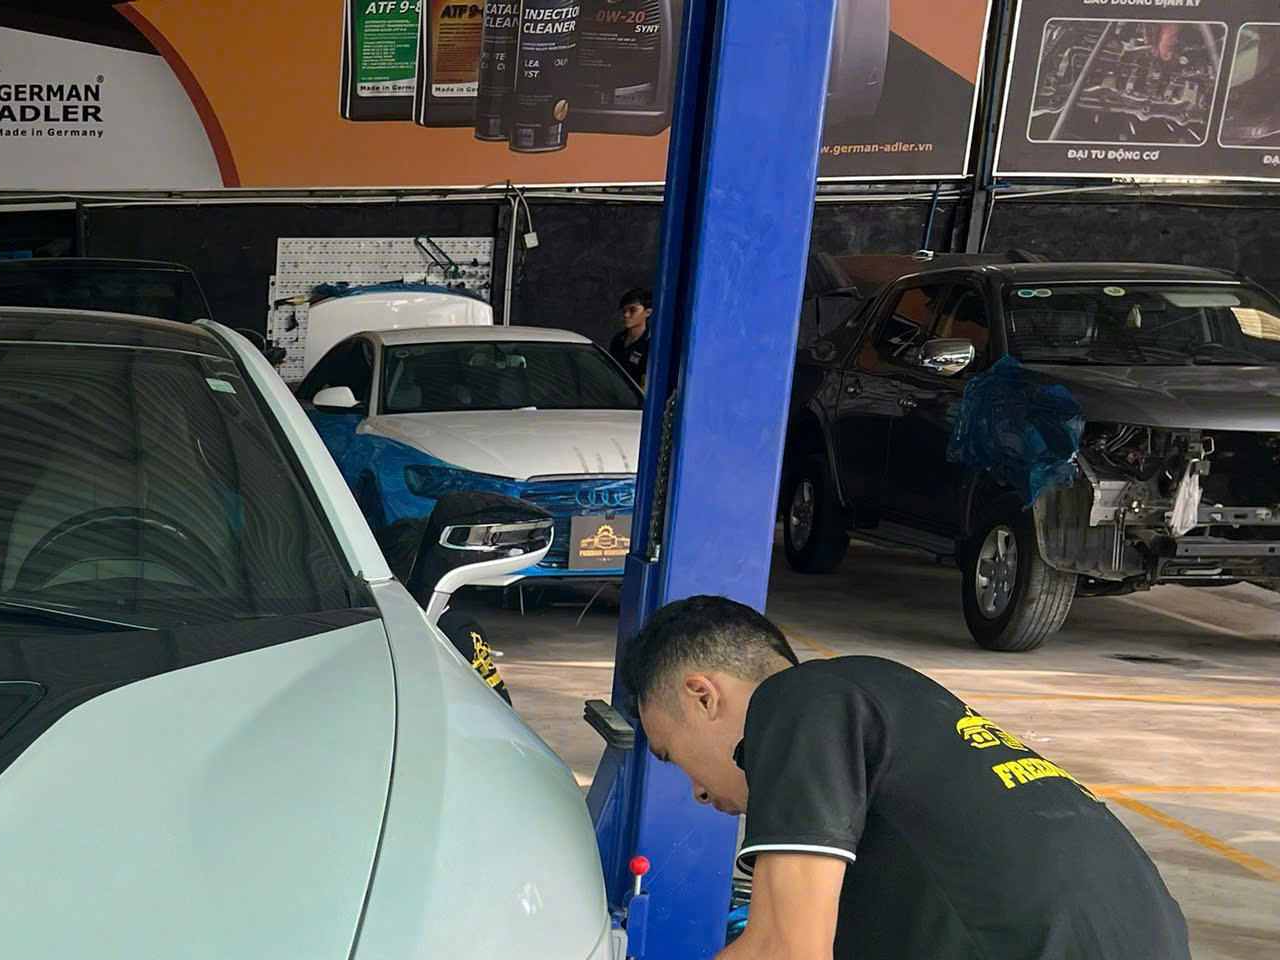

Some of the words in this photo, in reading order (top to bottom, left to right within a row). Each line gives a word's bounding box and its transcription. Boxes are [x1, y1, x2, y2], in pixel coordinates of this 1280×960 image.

[365, 1, 397, 14] ATF
[440, 4, 468, 18] ATF
[523, 21, 576, 34] CLEANER
[634, 25, 660, 33] SYNT
[31, 128, 43, 136] in
[47, 128, 104, 138] Germany
